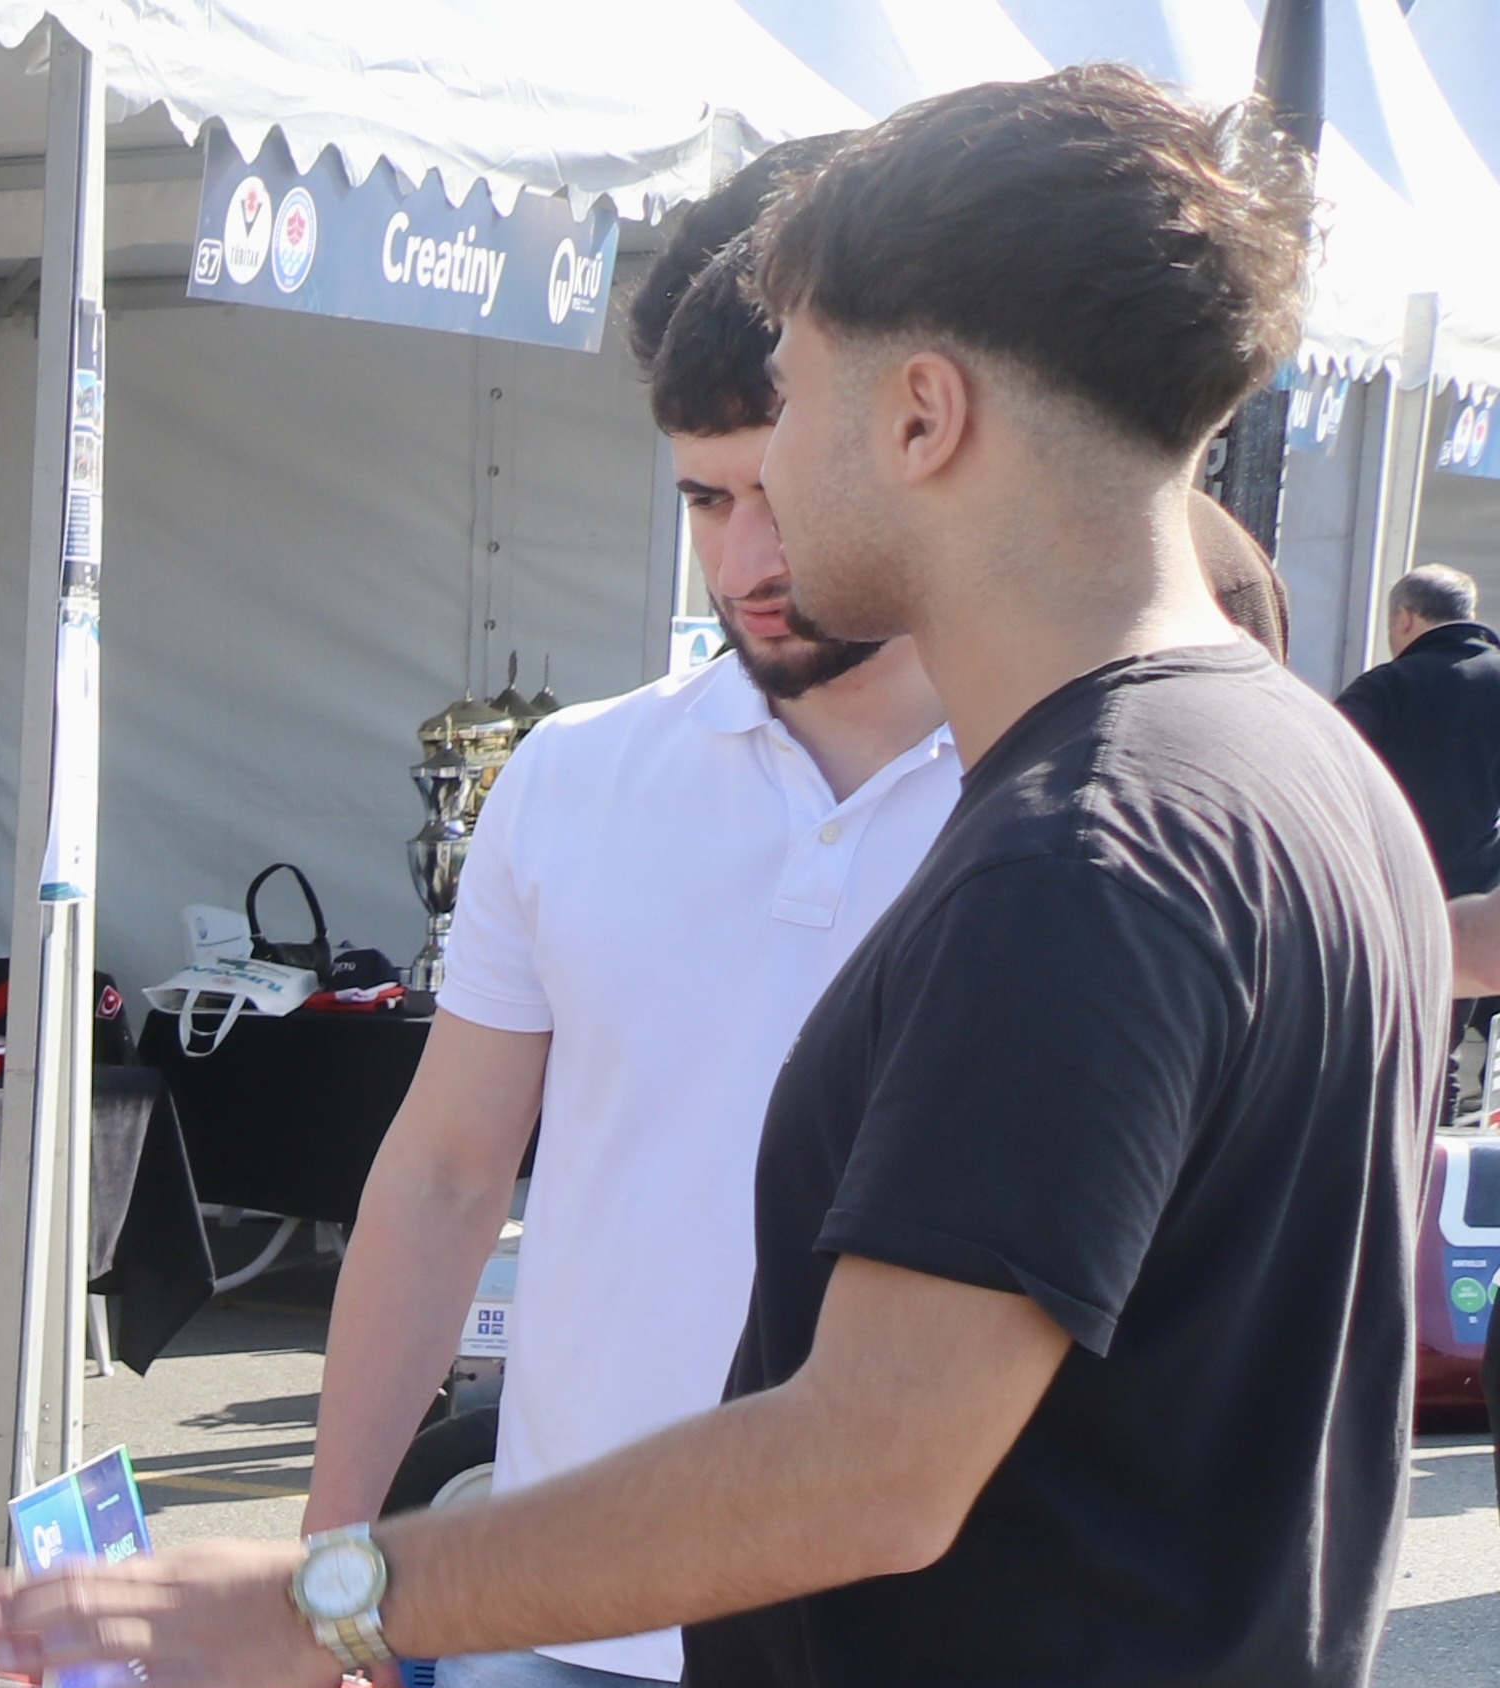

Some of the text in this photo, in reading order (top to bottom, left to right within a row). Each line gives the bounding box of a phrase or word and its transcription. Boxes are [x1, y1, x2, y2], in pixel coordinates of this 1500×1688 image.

[199, 244, 220, 279] 37
[381, 210, 506, 317] Creatiny
[572, 250, 604, 300] KTÜ
